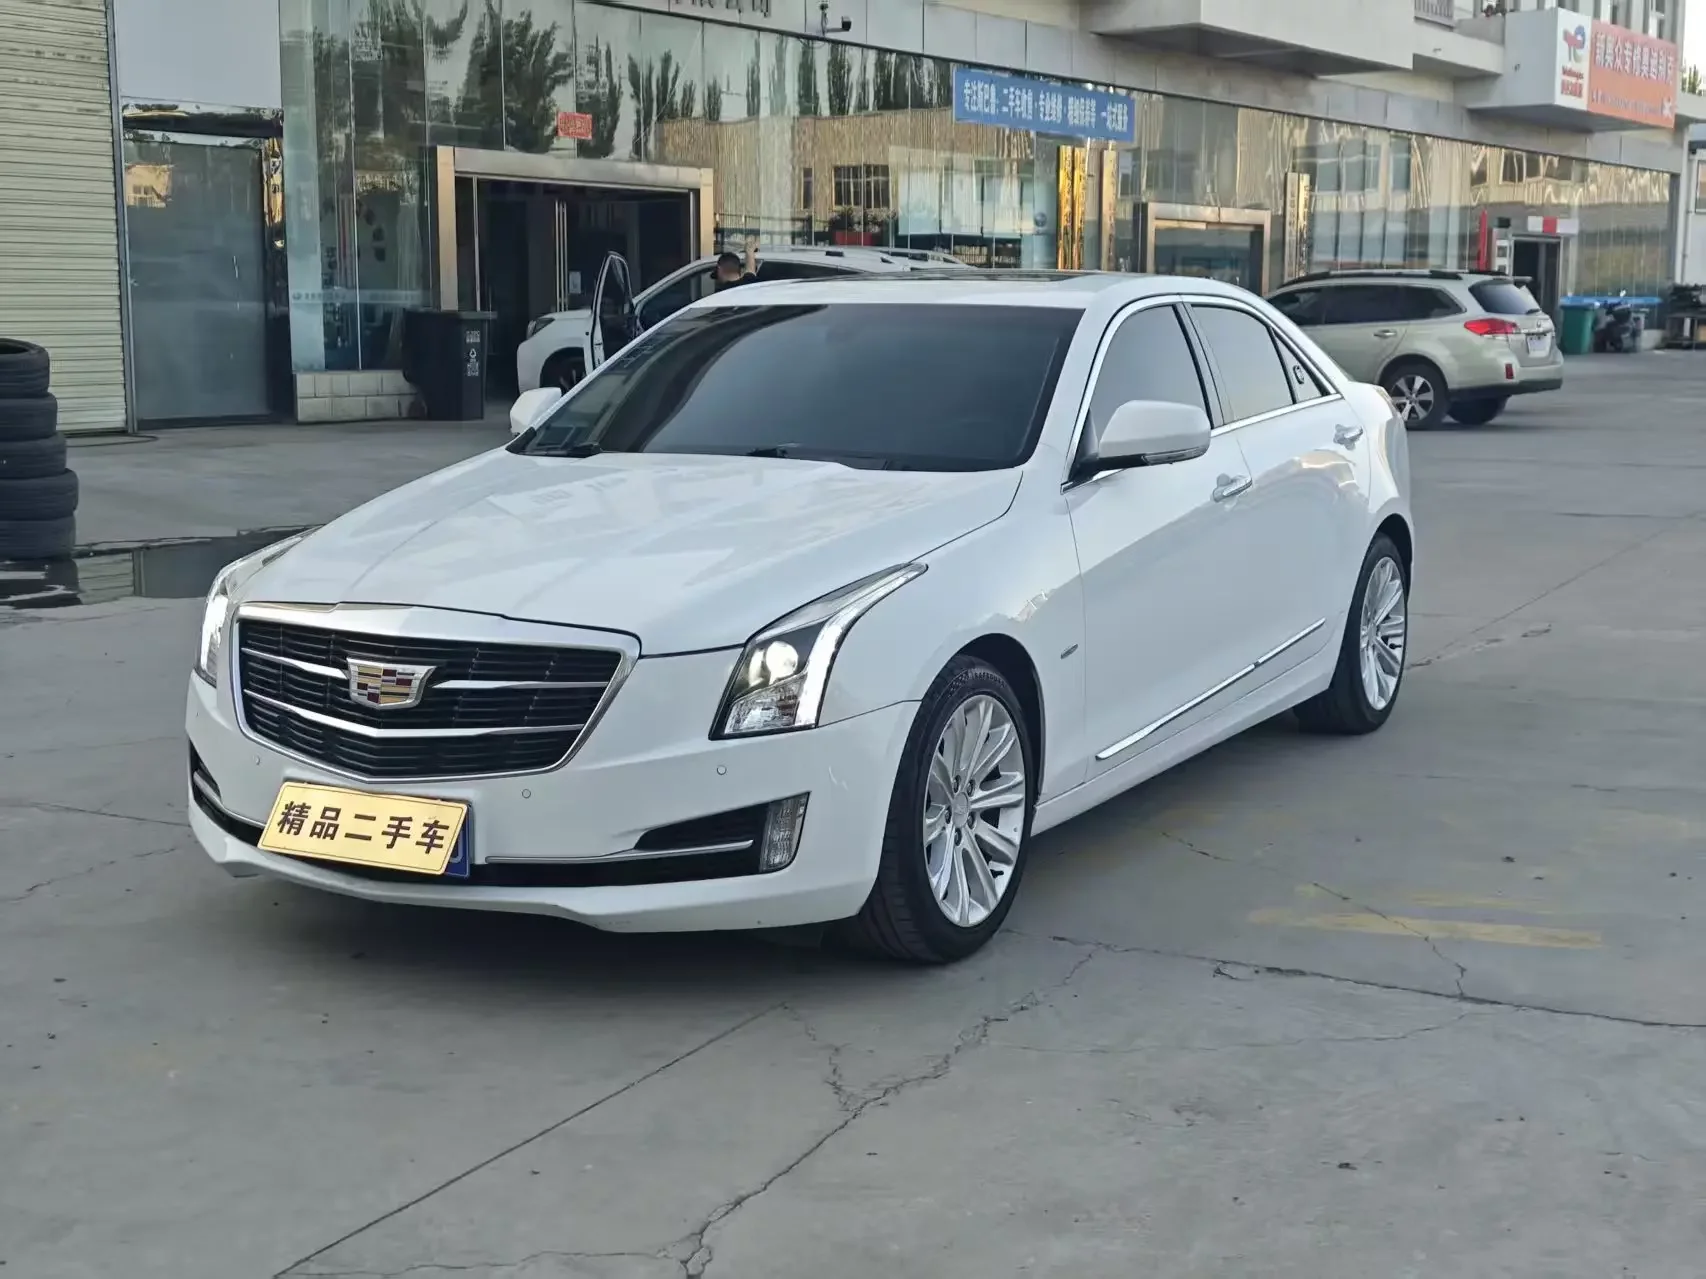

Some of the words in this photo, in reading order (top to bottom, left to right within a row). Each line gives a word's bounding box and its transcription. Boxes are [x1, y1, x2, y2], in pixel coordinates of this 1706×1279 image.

[277, 801, 450, 854] 精品二手车
